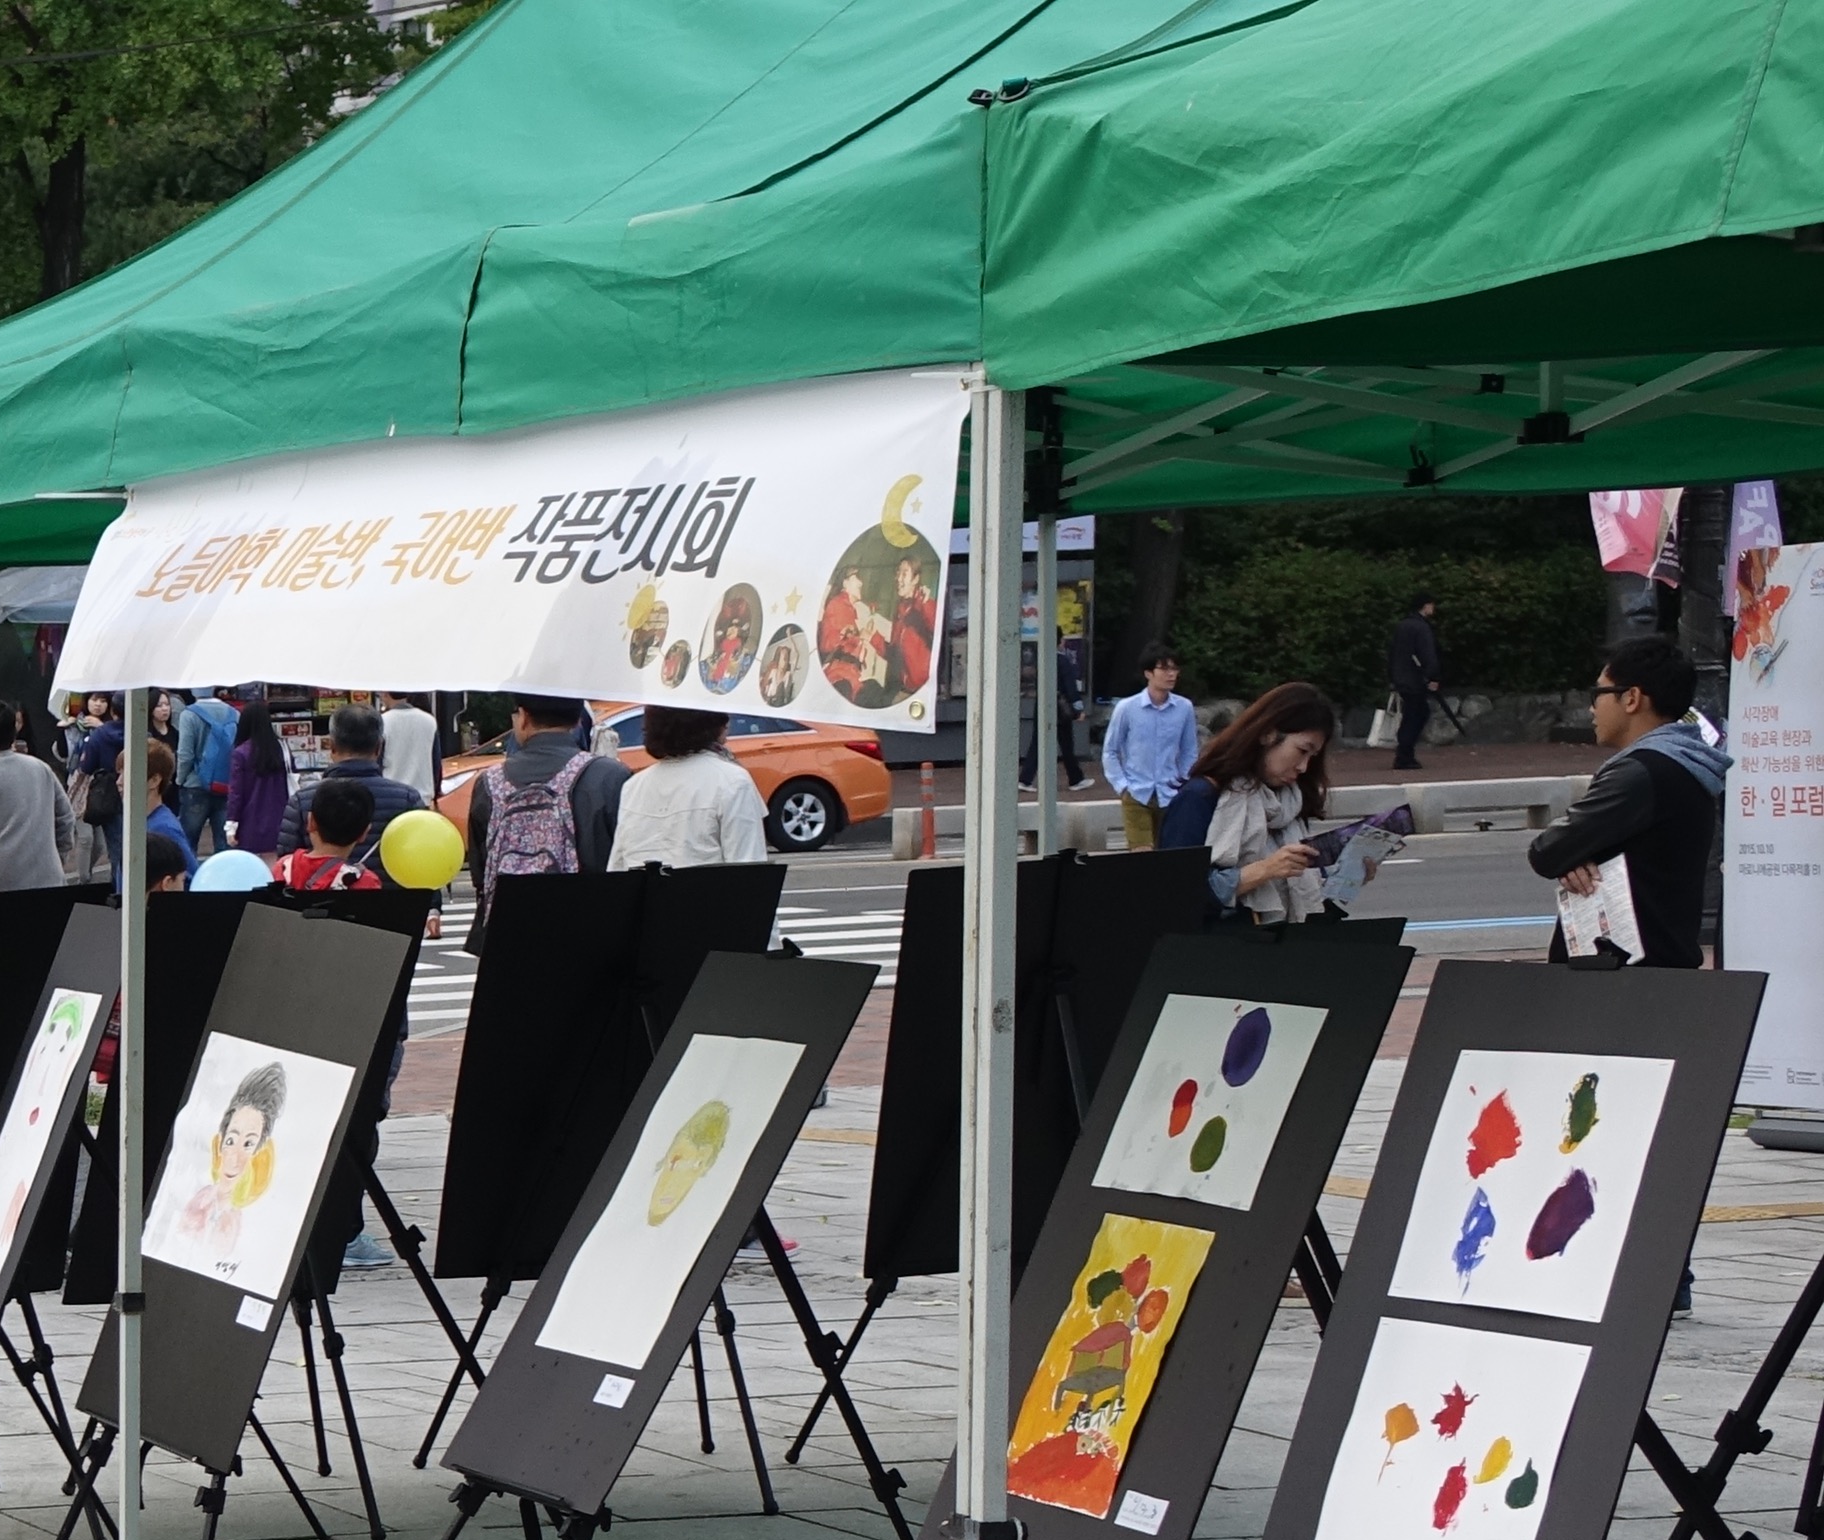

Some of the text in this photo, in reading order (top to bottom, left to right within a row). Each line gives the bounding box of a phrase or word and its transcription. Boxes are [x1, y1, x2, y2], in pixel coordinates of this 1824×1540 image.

[135, 527, 289, 603] 노들야학
[381, 503, 518, 587] 국어반
[499, 474, 759, 585] 작품전시회
[1742, 705, 1779, 722] 시각장애
[1741, 729, 1812, 748] 미술교육 현장과
[1762, 755, 1802, 773] 가능성을
